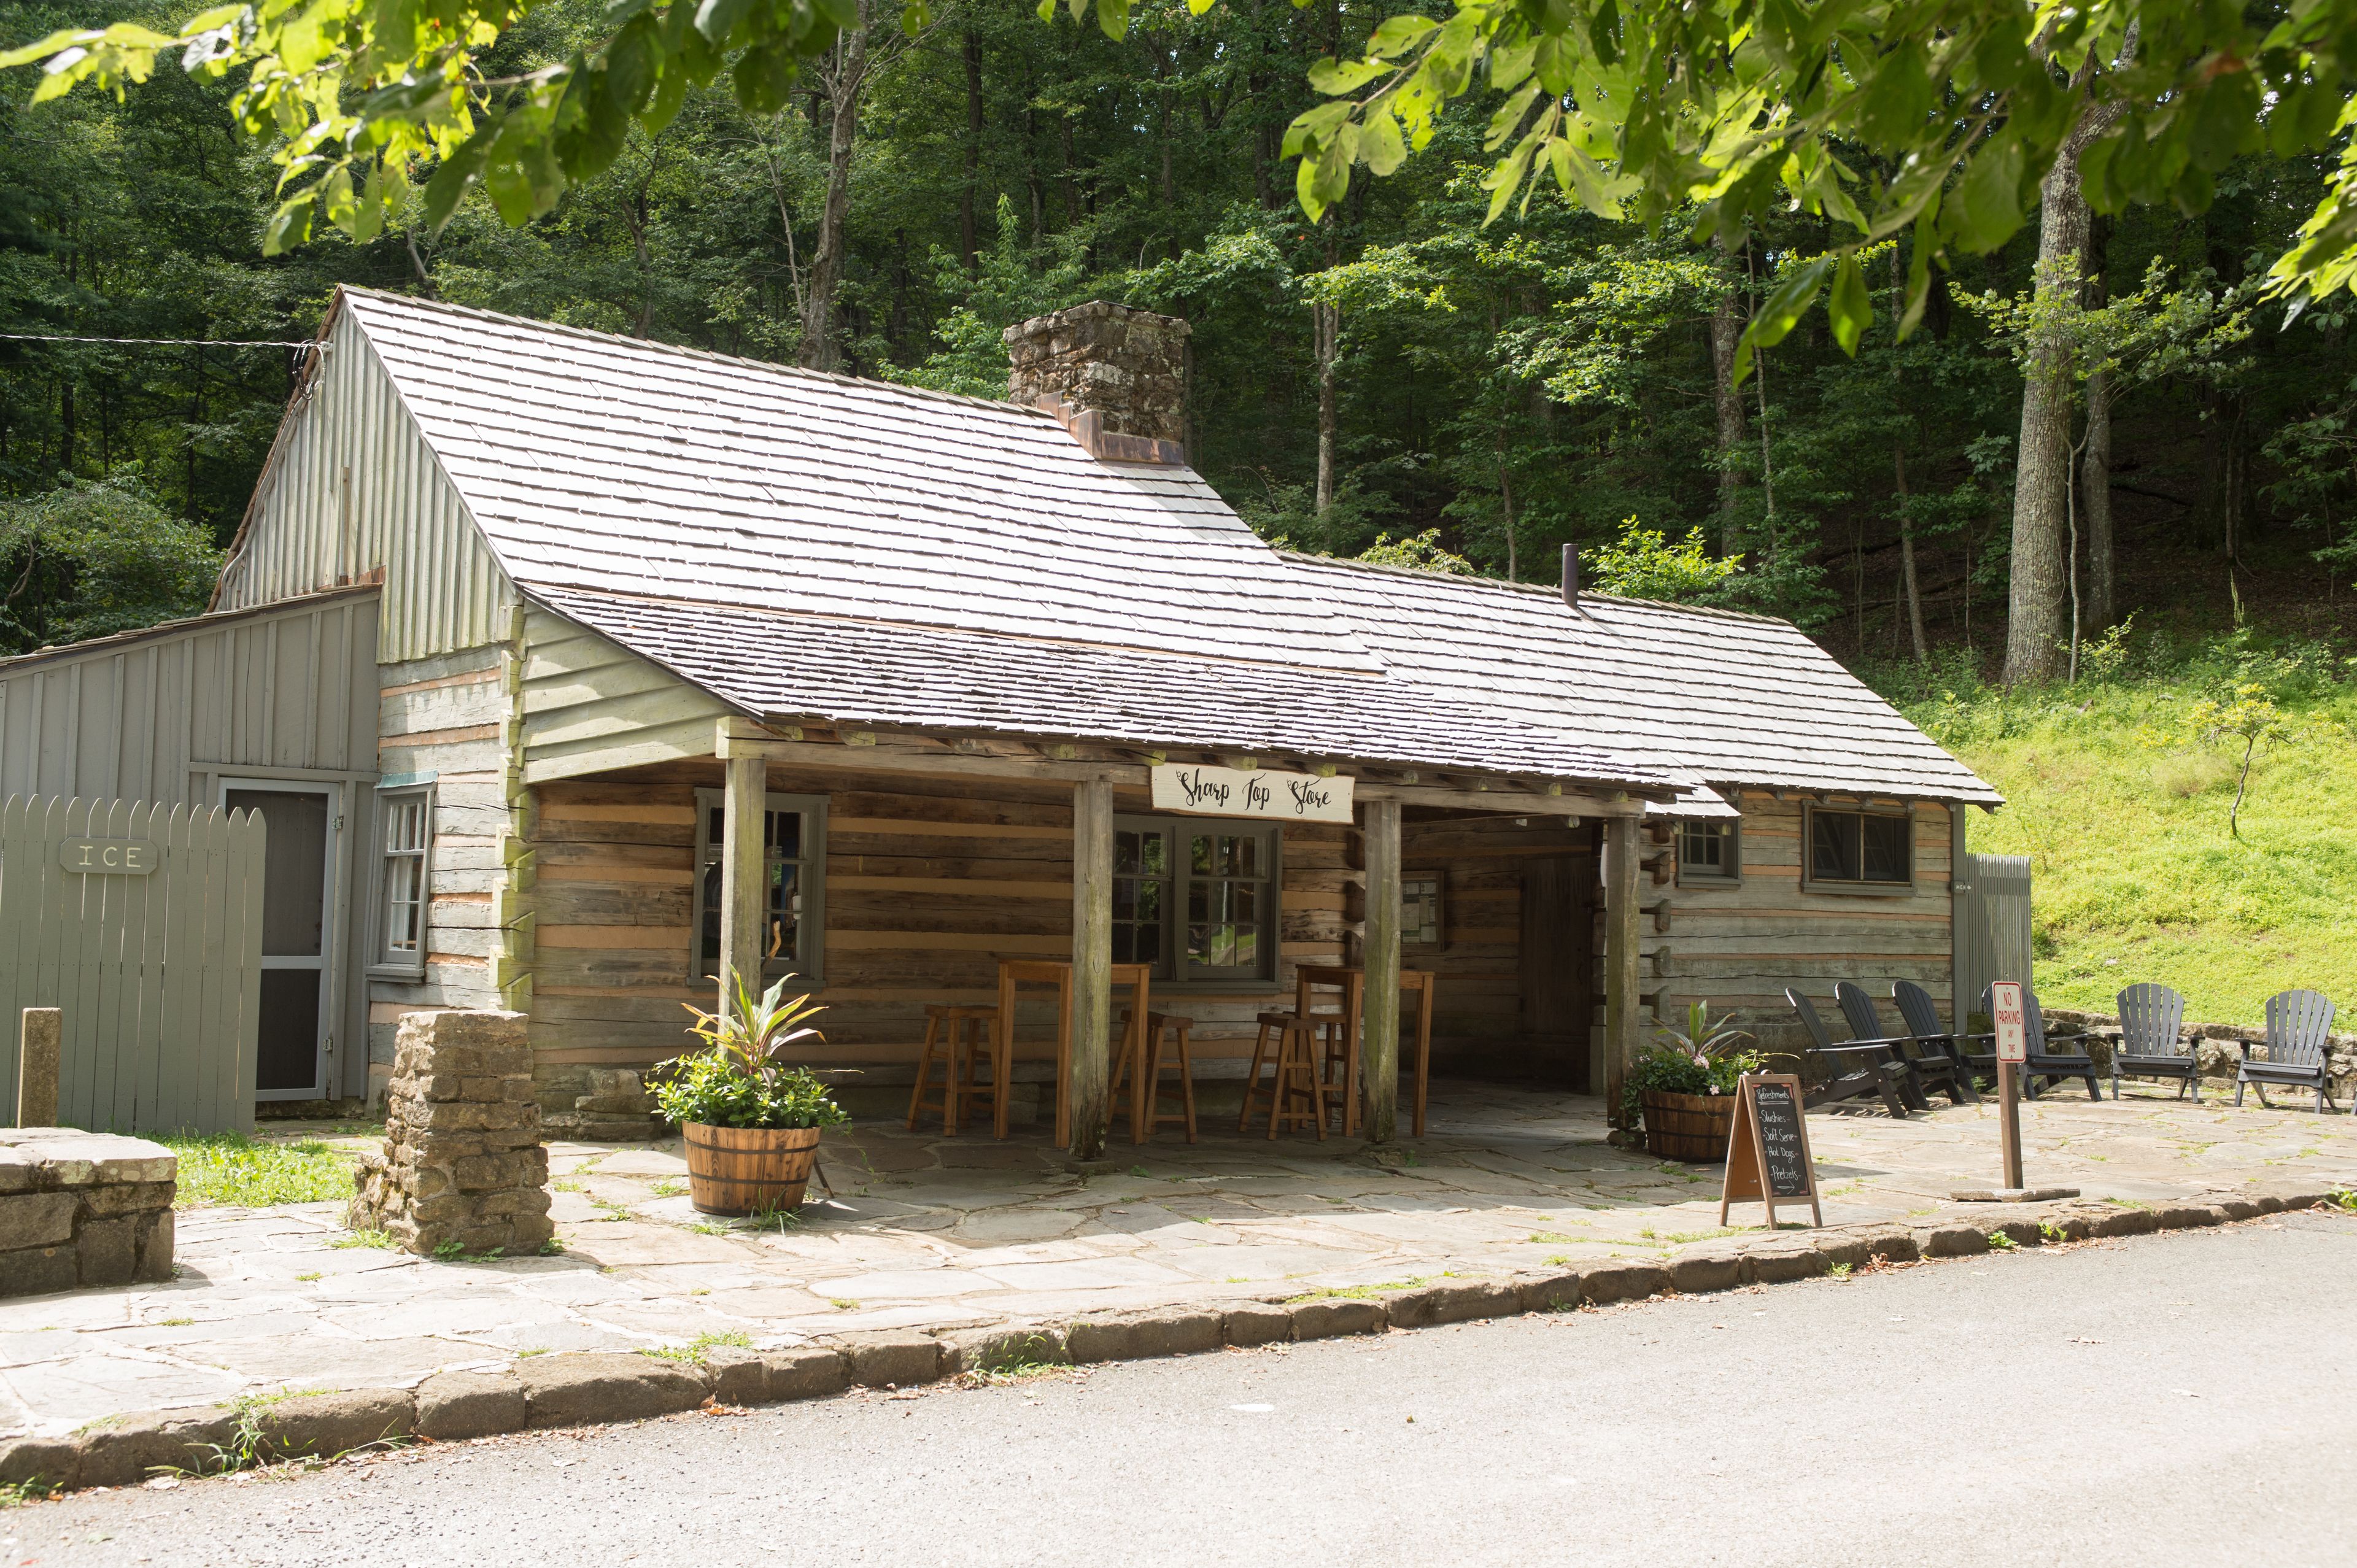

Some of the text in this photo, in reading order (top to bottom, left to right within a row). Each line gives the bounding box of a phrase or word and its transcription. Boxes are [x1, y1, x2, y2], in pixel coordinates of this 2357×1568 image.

[1175, 767, 1332, 814] Sharp Top Store
[78, 844, 142, 868] ICE
[2003, 992, 2012, 1006] NO
[1999, 1010, 2021, 1025] PARKING
[1755, 1087, 1790, 1102] Refreshments
